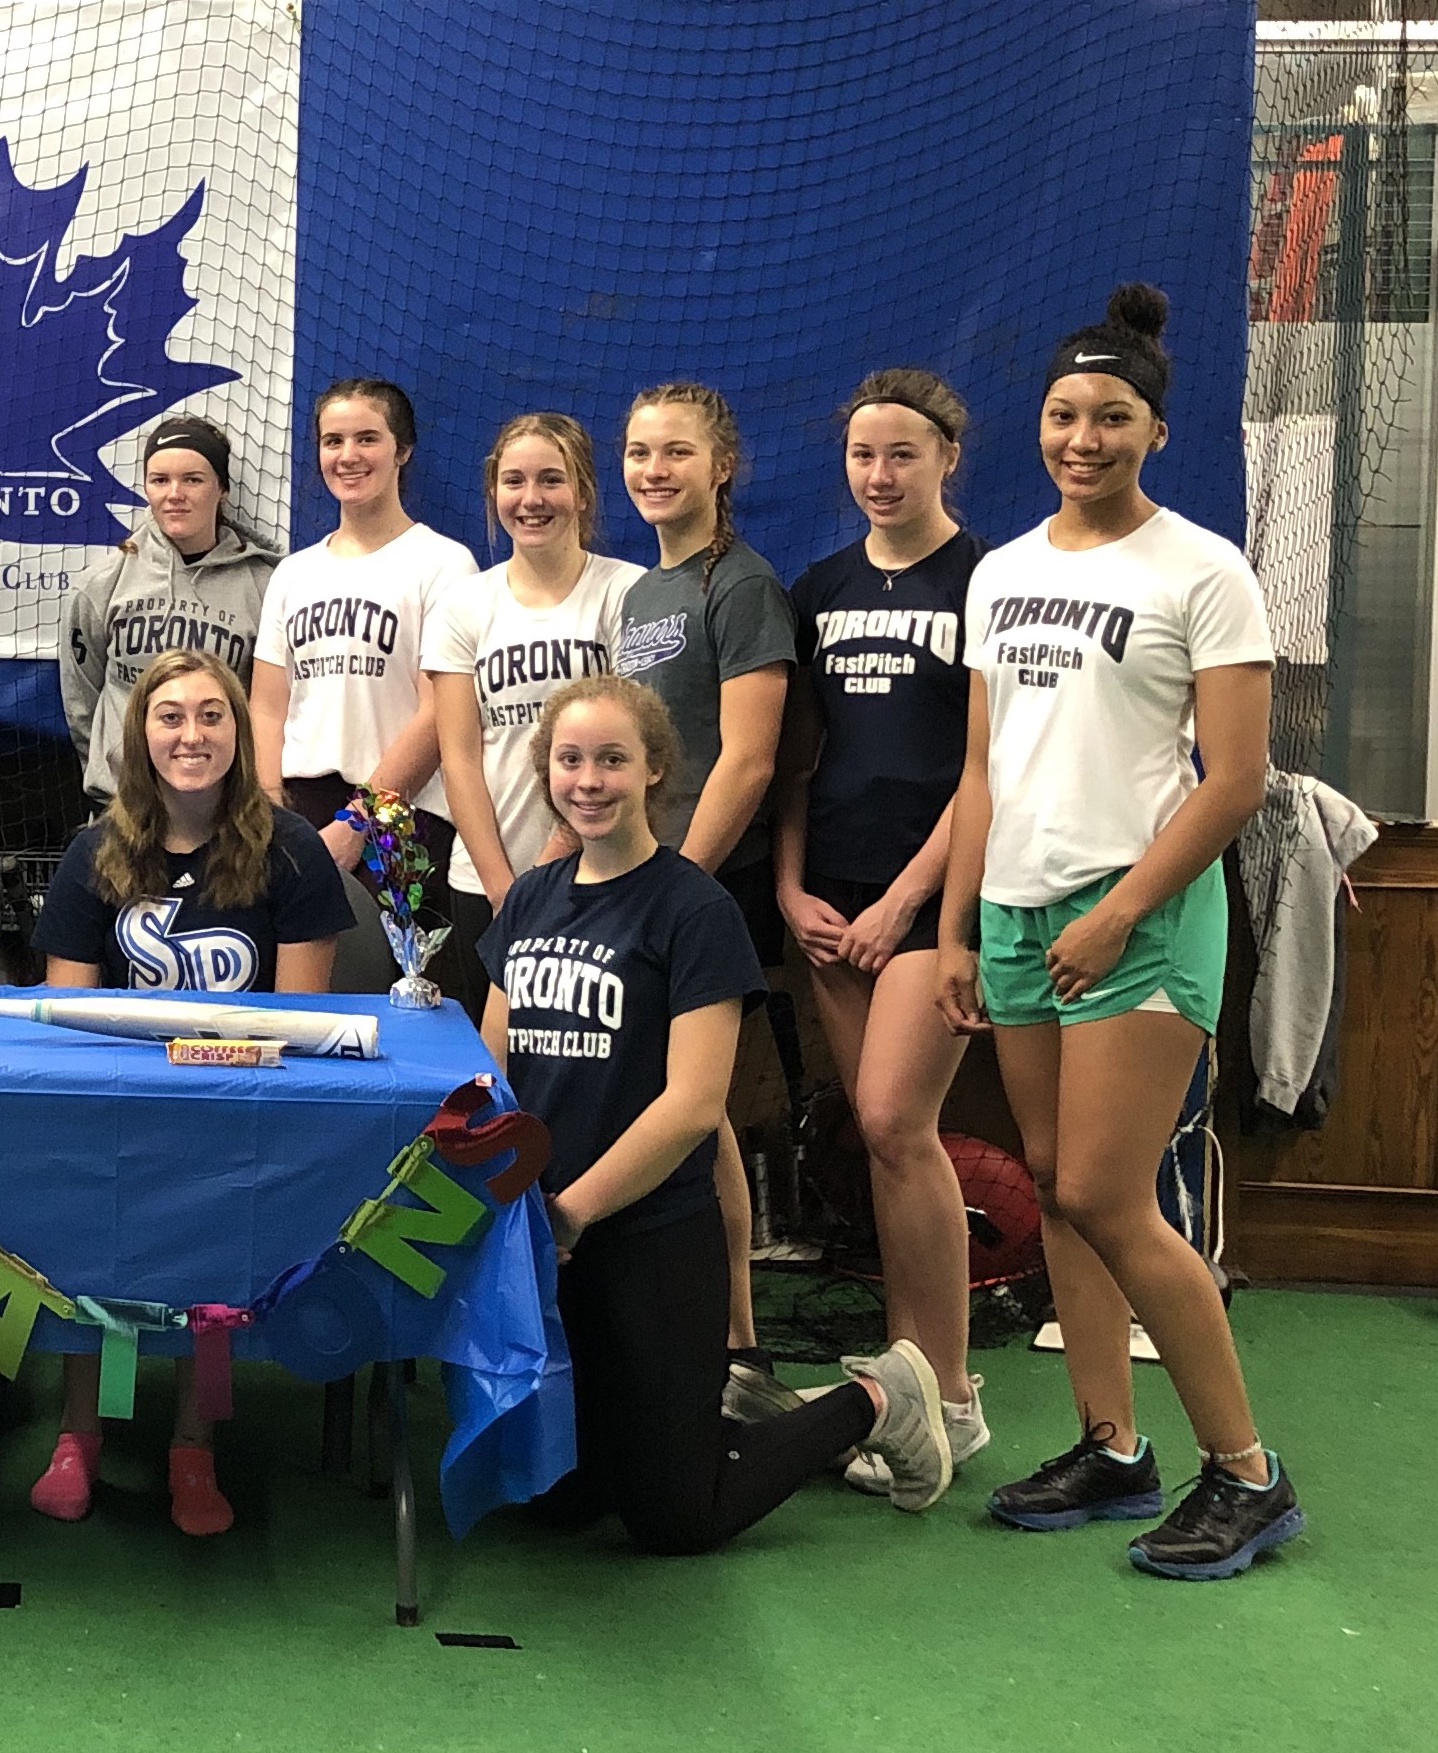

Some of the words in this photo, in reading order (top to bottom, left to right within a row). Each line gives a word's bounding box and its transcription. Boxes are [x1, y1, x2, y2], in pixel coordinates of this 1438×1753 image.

[124, 598, 210, 617] PROPRTY
[218, 610, 236, 626] OF
[286, 597, 399, 655] TORONTO
[113, 613, 245, 675] TORONTO
[814, 609, 958, 676] TORONTO
[983, 596, 1135, 664] TORONTO
[293, 655, 344, 680] ASTPITCH
[349, 655, 386, 678] CLUB
[825, 652, 916, 674] FastPitch
[997, 642, 1083, 670] FastPitch
[475, 638, 610, 703] TORONTO
[1018, 668, 1059, 689] CLUB
[844, 677, 892, 693] CLUB
[486, 701, 543, 727] FASTPIT
[592, 944, 615, 964] OF
[504, 956, 624, 1030] ORONTO
[190, 1044, 246, 1054] COFFEE
[508, 1028, 561, 1056] TPITCH
[562, 1030, 612, 1059] CLUB
